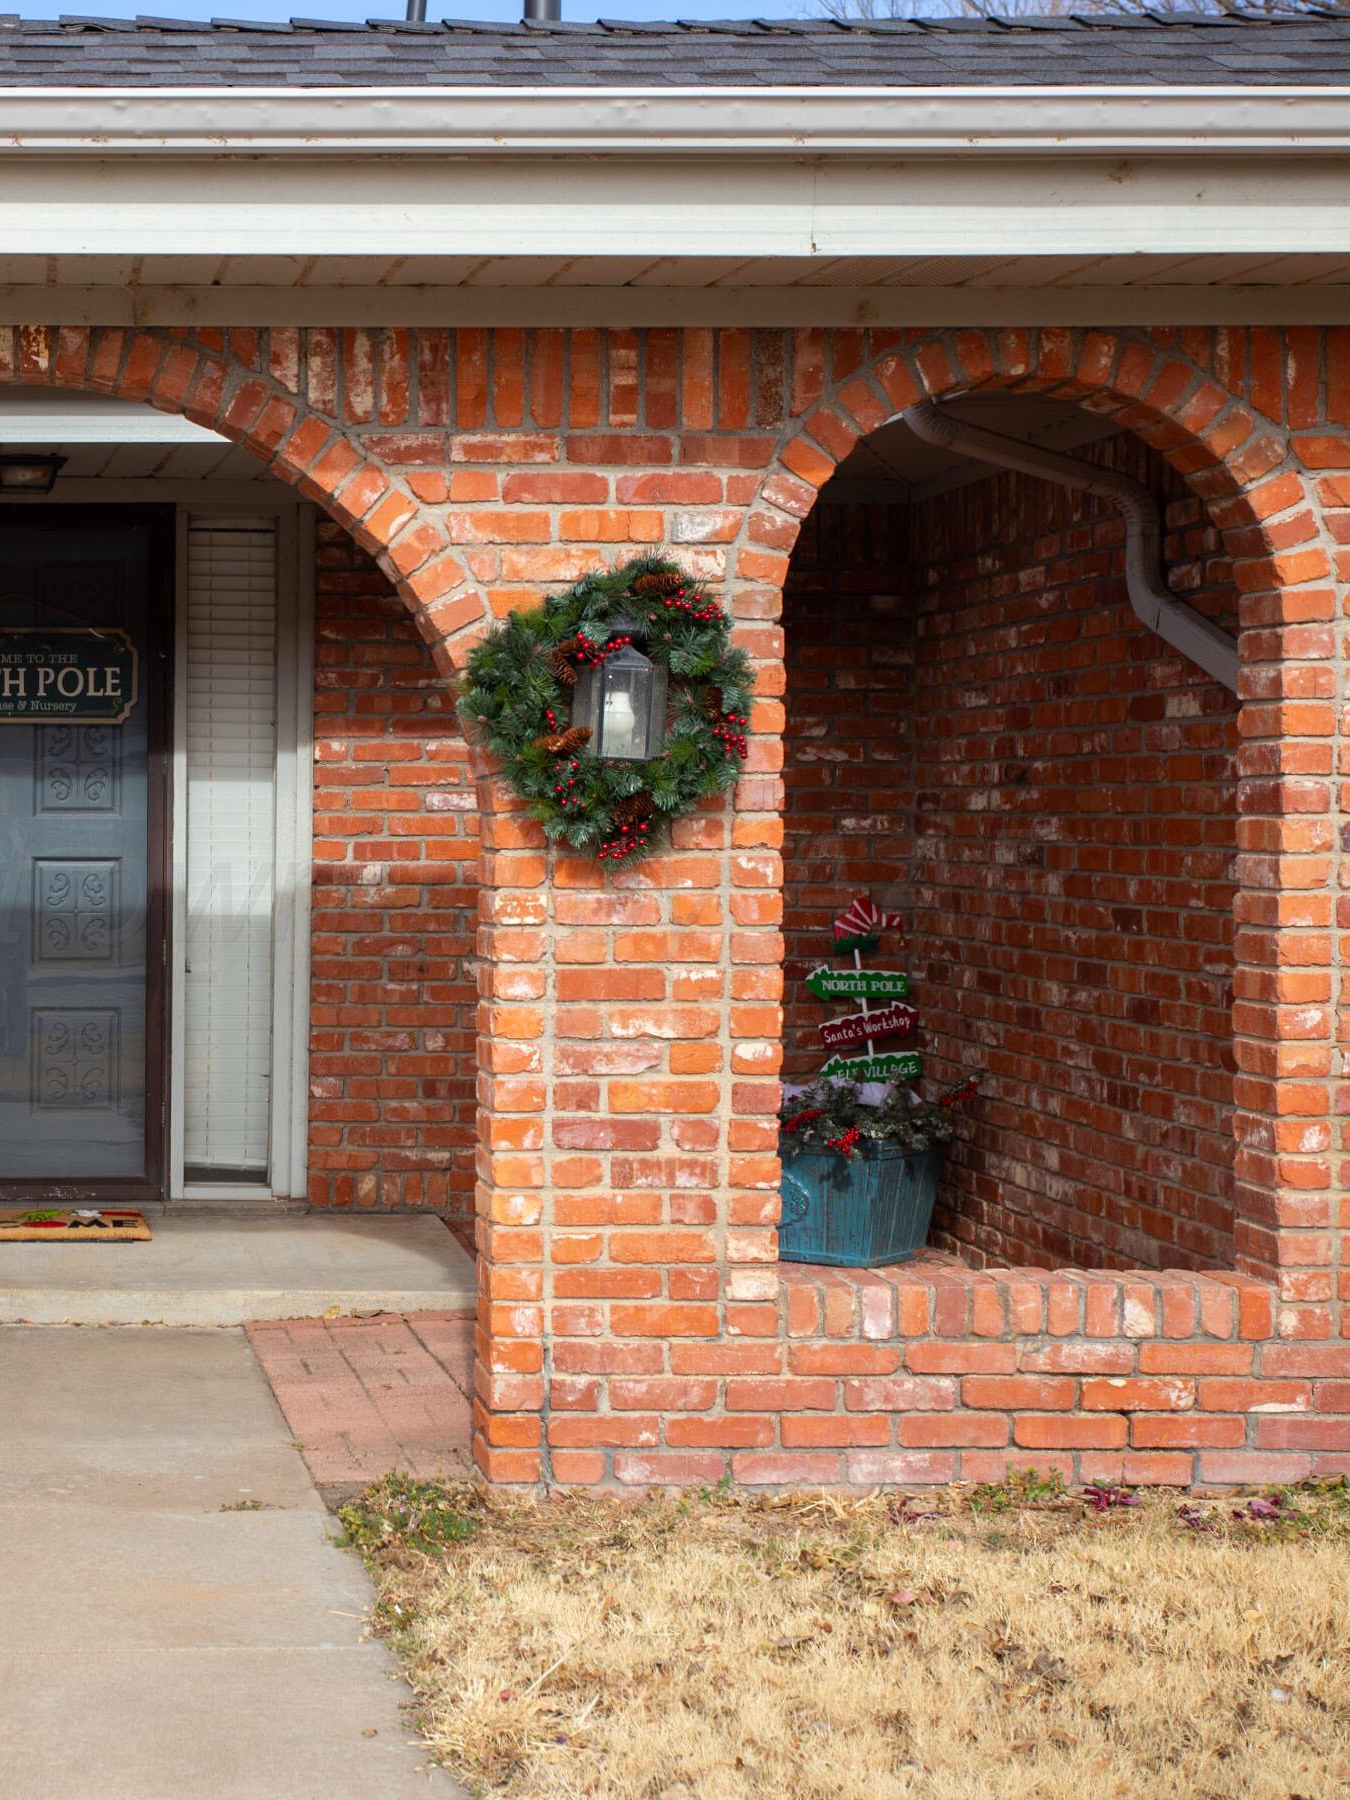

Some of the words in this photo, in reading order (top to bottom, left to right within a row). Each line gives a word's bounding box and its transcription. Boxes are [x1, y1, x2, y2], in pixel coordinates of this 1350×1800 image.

[26, 653, 45, 664] TO
[49, 653, 78, 664] THE
[37, 667, 122, 697] POLE
[30, 700, 77, 712] Nursery
[821, 979, 867, 992] NORTH
[870, 980, 905, 992] POLE
[824, 1024, 864, 1044] Santa's
[863, 1016, 911, 1034] Workshop
